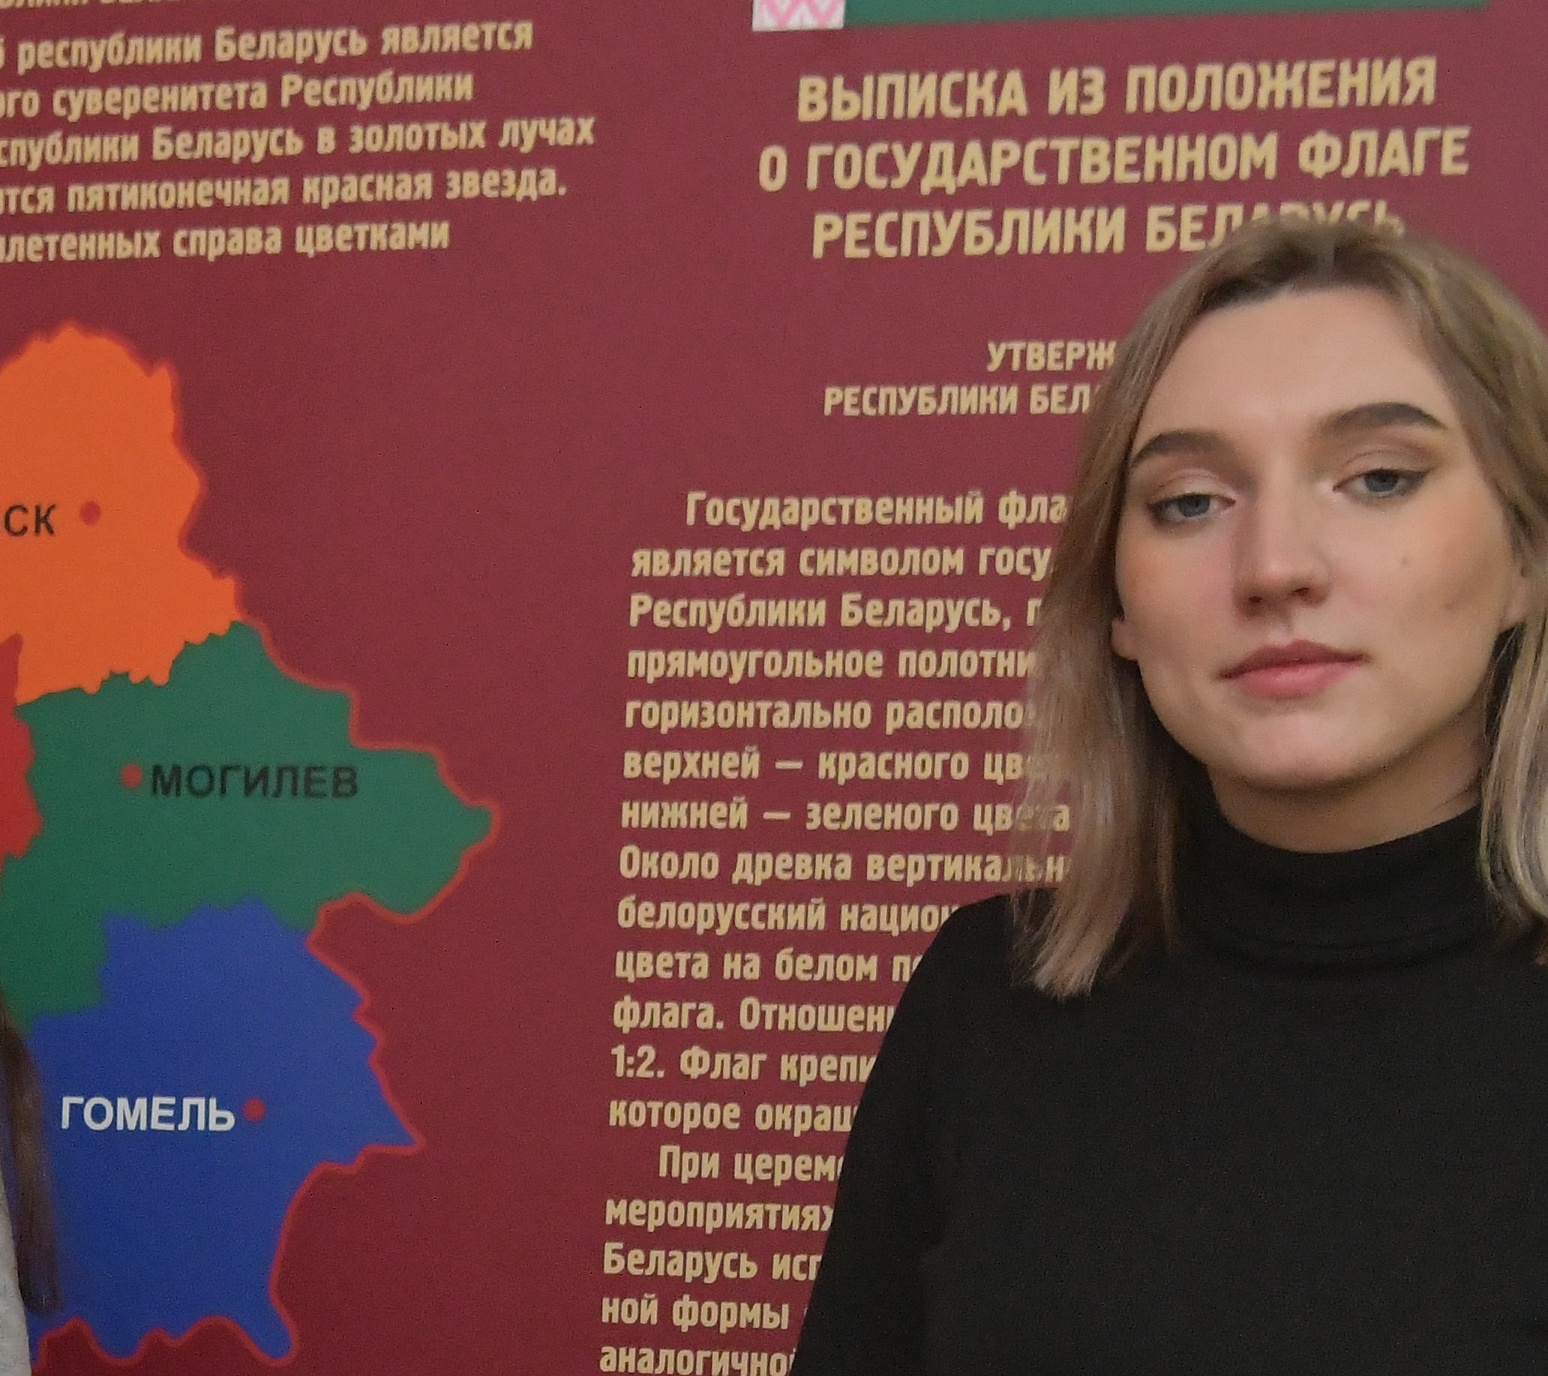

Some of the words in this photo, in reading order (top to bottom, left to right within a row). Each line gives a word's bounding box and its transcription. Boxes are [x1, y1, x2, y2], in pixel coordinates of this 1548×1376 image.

[17, 31, 202, 76] республики
[214, 25, 369, 65] Беларусь
[380, 20, 534, 55] является
[52, 80, 268, 123] суверенитета
[280, 68, 474, 112] Республики
[797, 69, 1029, 122] ВЫПИСКА
[1047, 66, 1106, 116] ИЗ
[1125, 55, 1437, 113] ПОЛОЖЕНИЯ
[152, 125, 305, 164] Беларусь
[316, 125, 337, 155] в
[348, 119, 487, 154] золотых
[497, 115, 596, 154] лучах
[758, 144, 788, 192] О
[806, 131, 1278, 196] ГОСУДАРСТВЕННОМ
[1298, 126, 1470, 179] ФЛАГЕ
[67, 176, 290, 212] пятиконечная
[302, 171, 434, 210] красная
[445, 166, 567, 202] звезда.
[172, 225, 283, 263] справа
[295, 220, 450, 258] цветками
[812, 206, 1126, 259] РЕСПУБЛИКИ
[823, 384, 1019, 416] РЕСПУБЛИКИ
[1029, 383, 1089, 415] БЕЛ
[686, 490, 985, 532] Государственный
[631, 547, 786, 577] является
[799, 546, 965, 577] символом
[629, 592, 827, 634] Республики
[840, 592, 1011, 634] Беларусь,
[627, 649, 884, 685] прямоугольное
[625, 700, 872, 735] горизонтально
[150, 763, 359, 799] МОГИЛЕВ
[623, 745, 761, 785] верхней
[818, 751, 970, 786] красного
[621, 795, 749, 830] нижней
[805, 801, 959, 831] зеленого
[619, 844, 720, 880] Около
[731, 852, 853, 886] древка
[617, 894, 827, 936] белорусский
[615, 950, 710, 983] цвета
[723, 952, 761, 981] на
[774, 946, 879, 982] белом
[613, 994, 724, 1034] флага.
[610, 1044, 665, 1079] 1:2.
[679, 1045, 768, 1080] Флаг
[60, 1095, 236, 1132] ГОМЕЛЬ
[609, 1099, 741, 1135] которое
[658, 1144, 720, 1184] При
[603, 1241, 758, 1284] Беларусь
[601, 1292, 659, 1325] ной
[672, 1293, 790, 1334] формы
